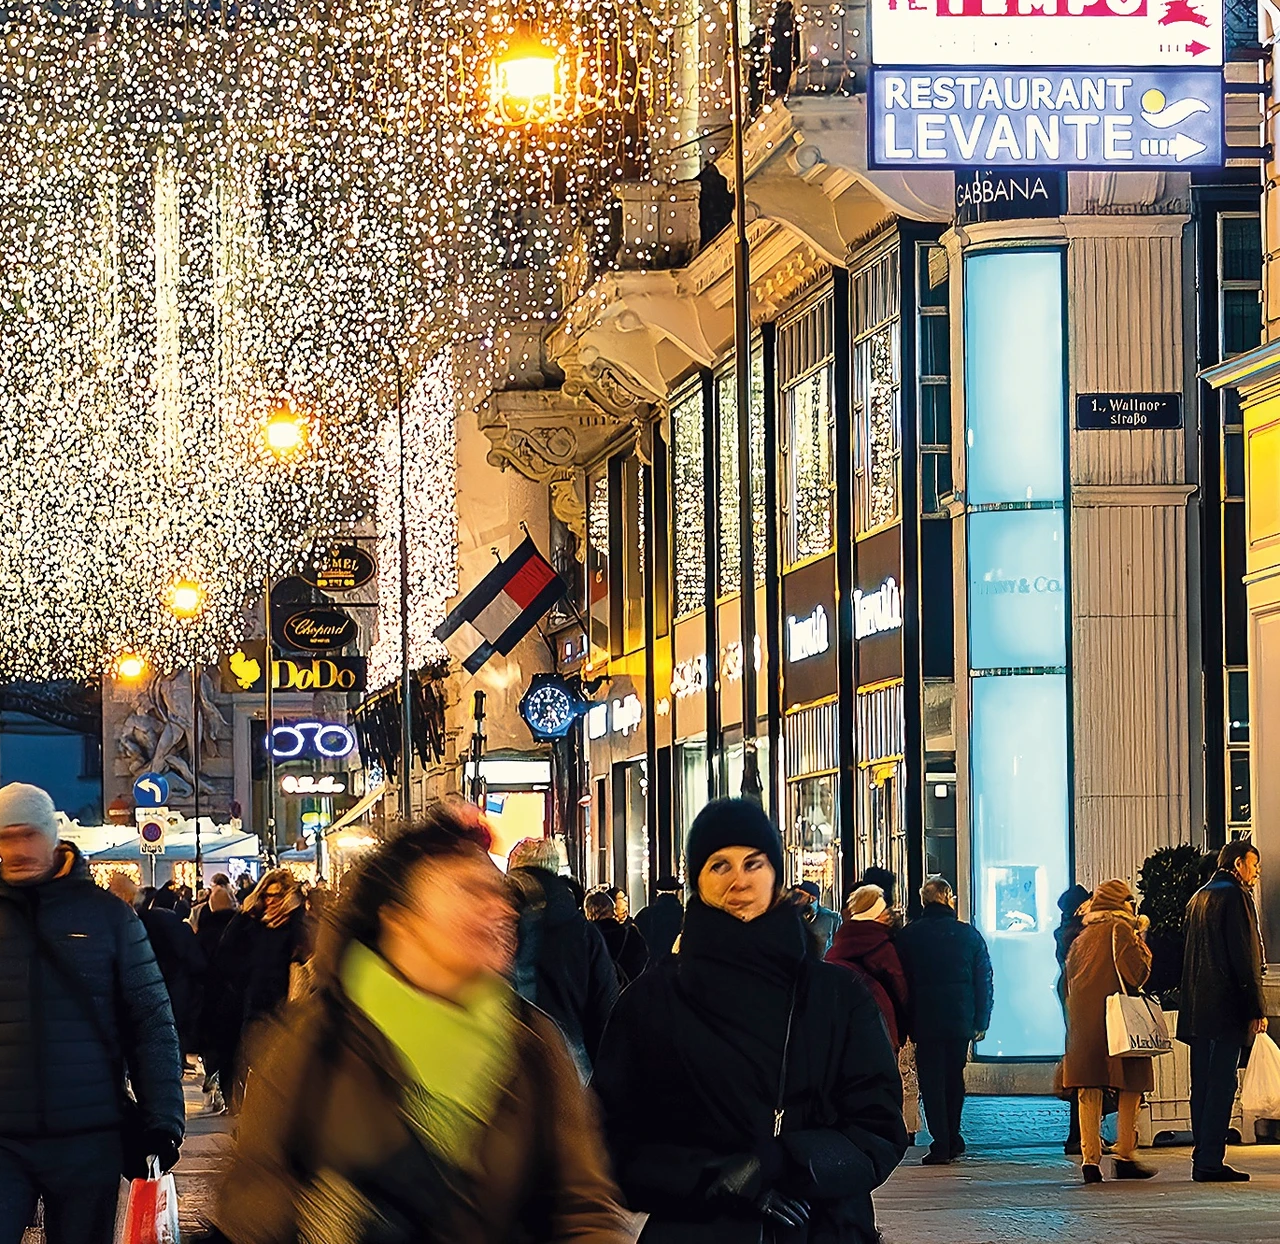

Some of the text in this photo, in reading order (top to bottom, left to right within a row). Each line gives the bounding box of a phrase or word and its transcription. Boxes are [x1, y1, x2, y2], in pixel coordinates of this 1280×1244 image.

[884, 76, 1134, 110] RESTAURANT
[884, 113, 1134, 160] LEVANTE
[956, 176, 1049, 208] GABBANA
[290, 617, 350, 637] Chopard
[271, 658, 356, 690] DoDo
